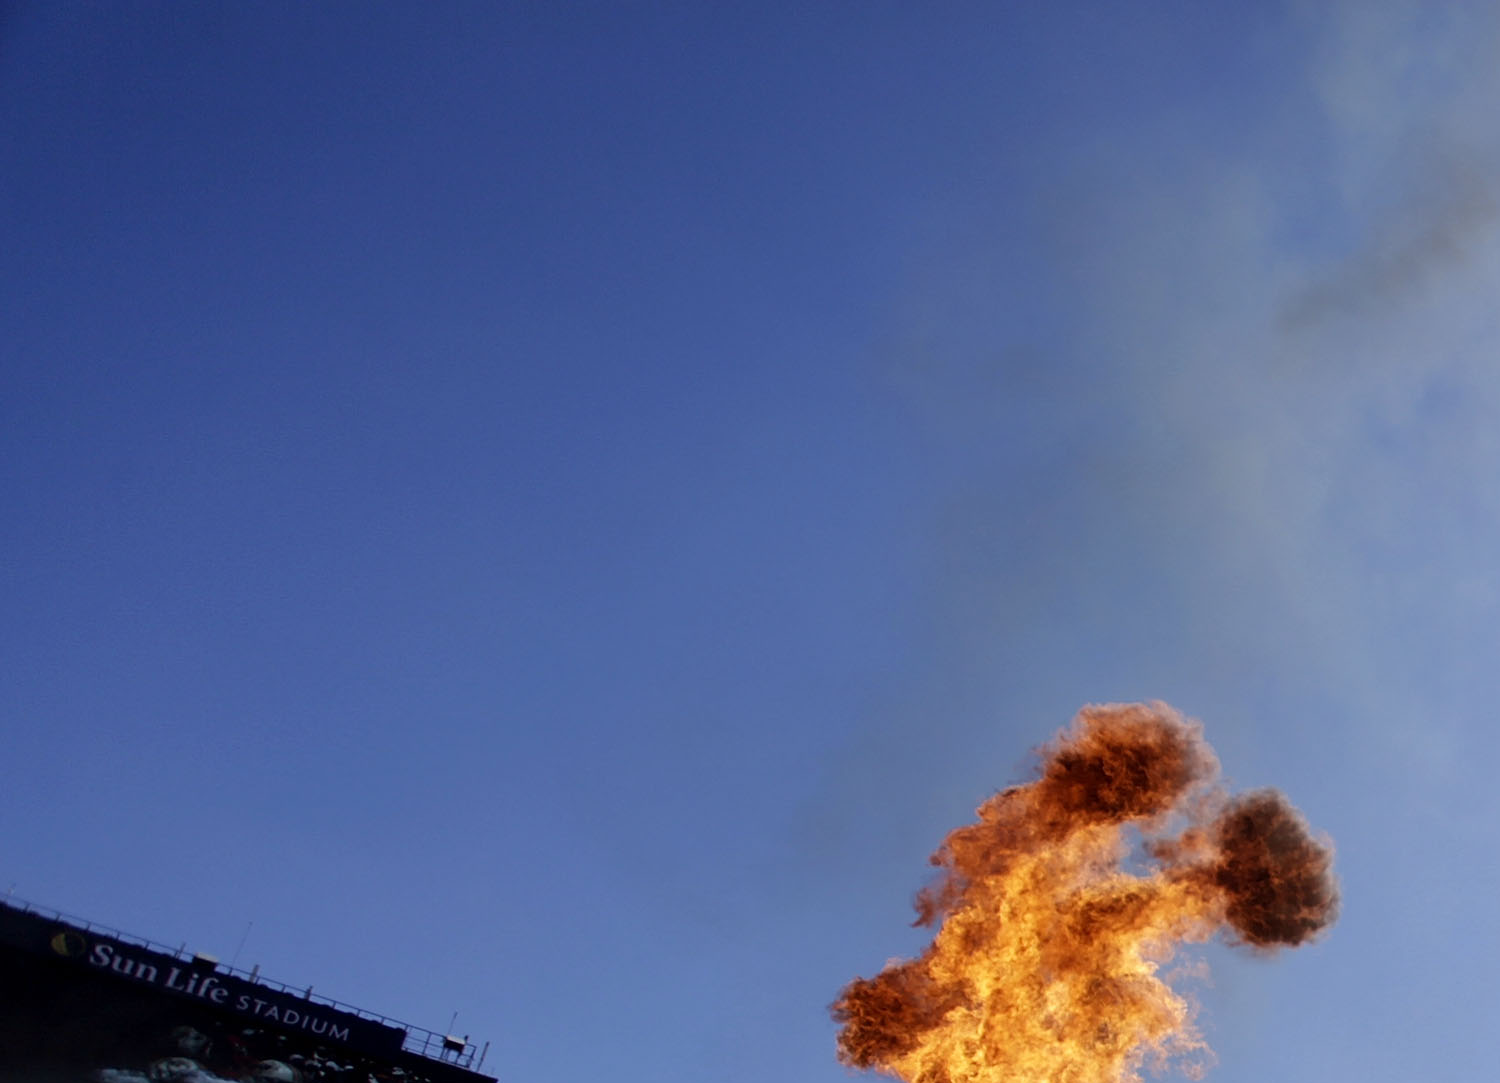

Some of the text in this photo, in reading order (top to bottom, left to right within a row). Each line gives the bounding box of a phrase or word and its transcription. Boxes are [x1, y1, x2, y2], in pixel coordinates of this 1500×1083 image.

[89, 943, 351, 1042] Sun Life STADIUM
